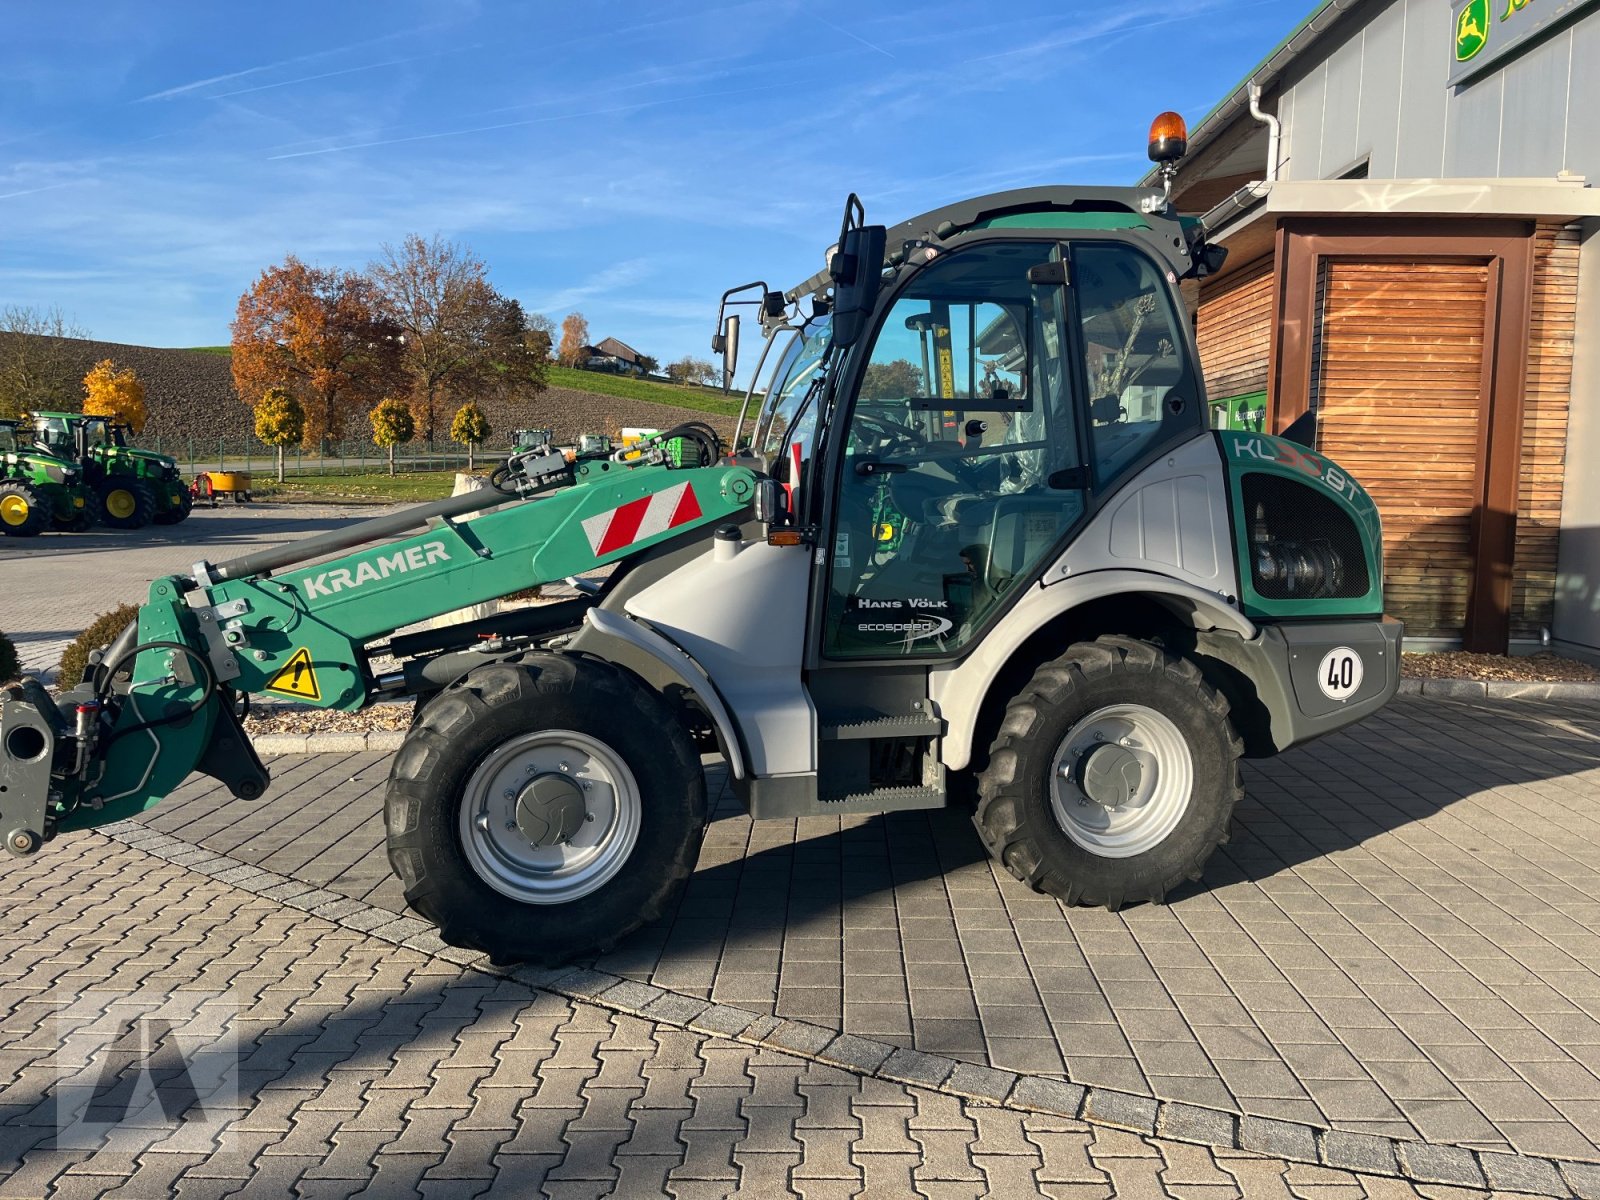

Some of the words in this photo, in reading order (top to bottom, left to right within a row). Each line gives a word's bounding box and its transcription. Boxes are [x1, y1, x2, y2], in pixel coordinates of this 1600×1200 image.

[303, 541, 452, 600] KRAMER
[858, 623, 932, 633] ecospeed
[1327, 657, 1353, 690] 40
